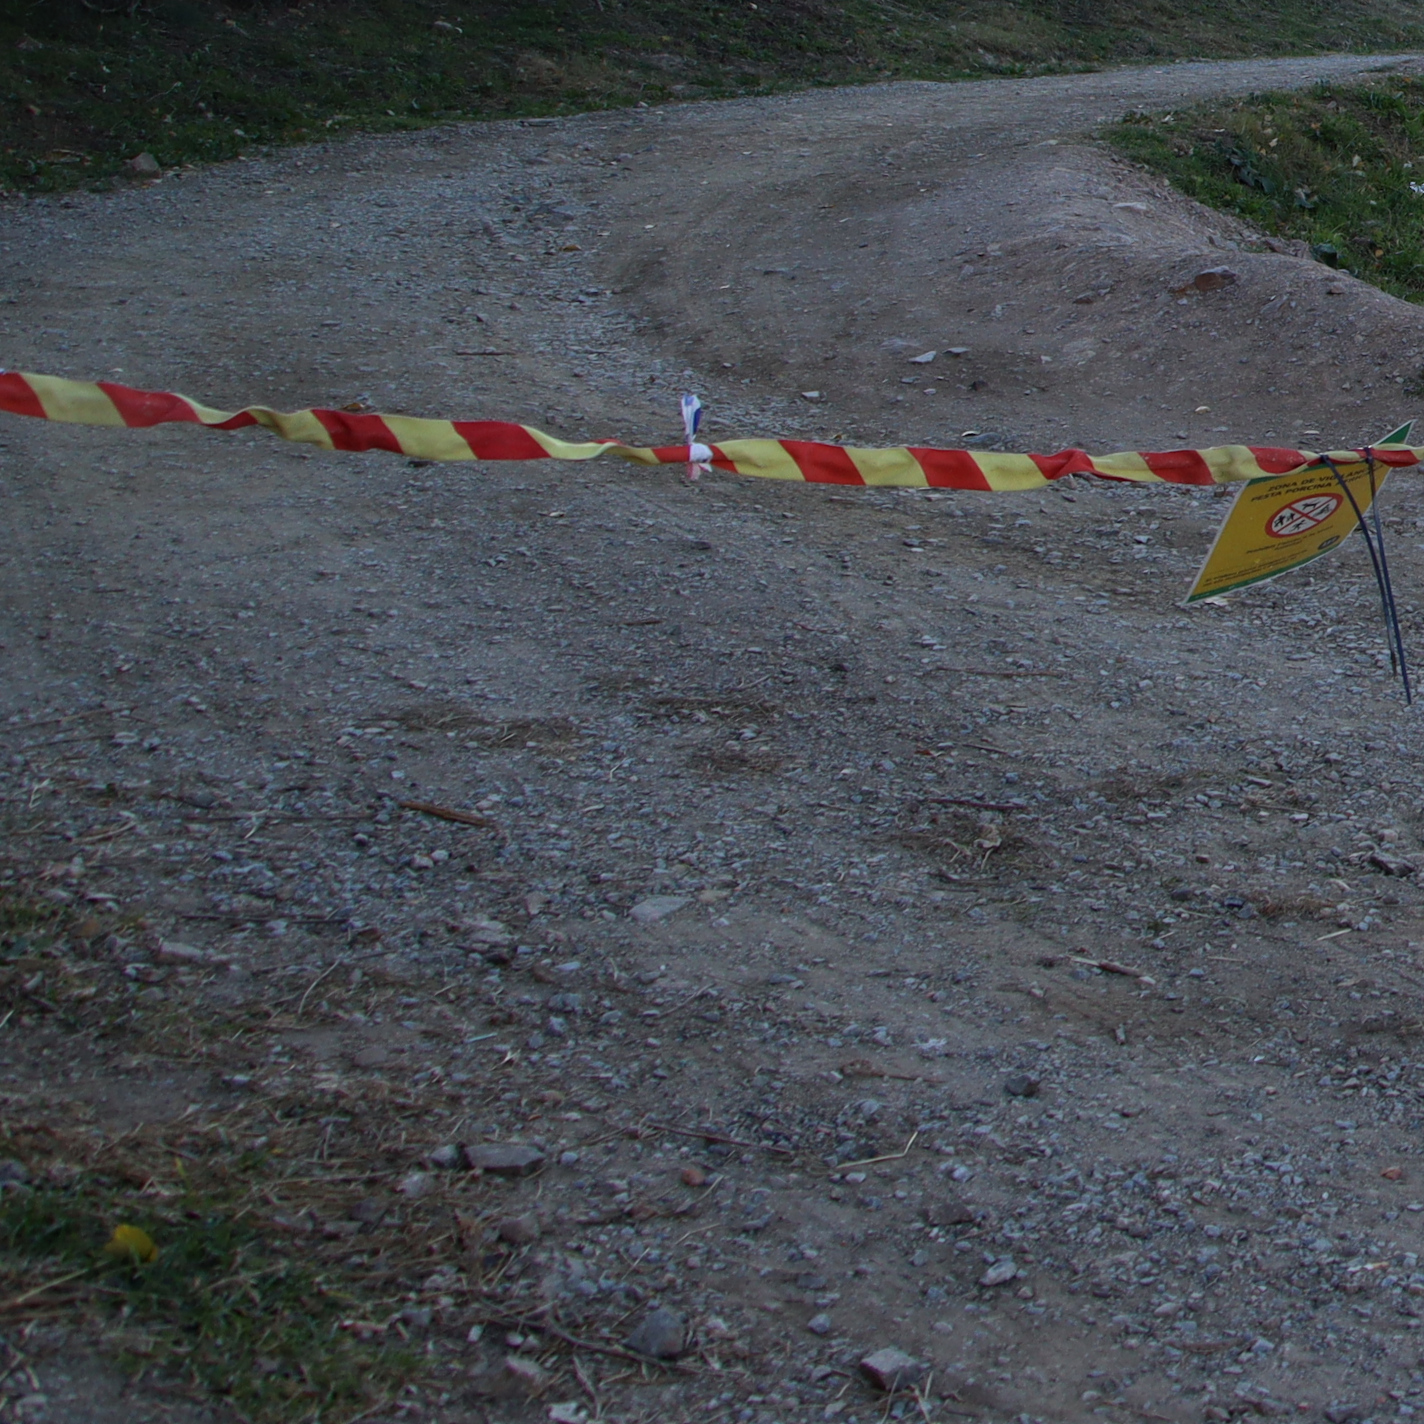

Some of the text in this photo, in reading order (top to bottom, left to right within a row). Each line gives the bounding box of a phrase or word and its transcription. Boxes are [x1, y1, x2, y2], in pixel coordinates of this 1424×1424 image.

[1250, 483, 1332, 502] PESTA PORCINA
[1268, 481, 1298, 492] ZONA
